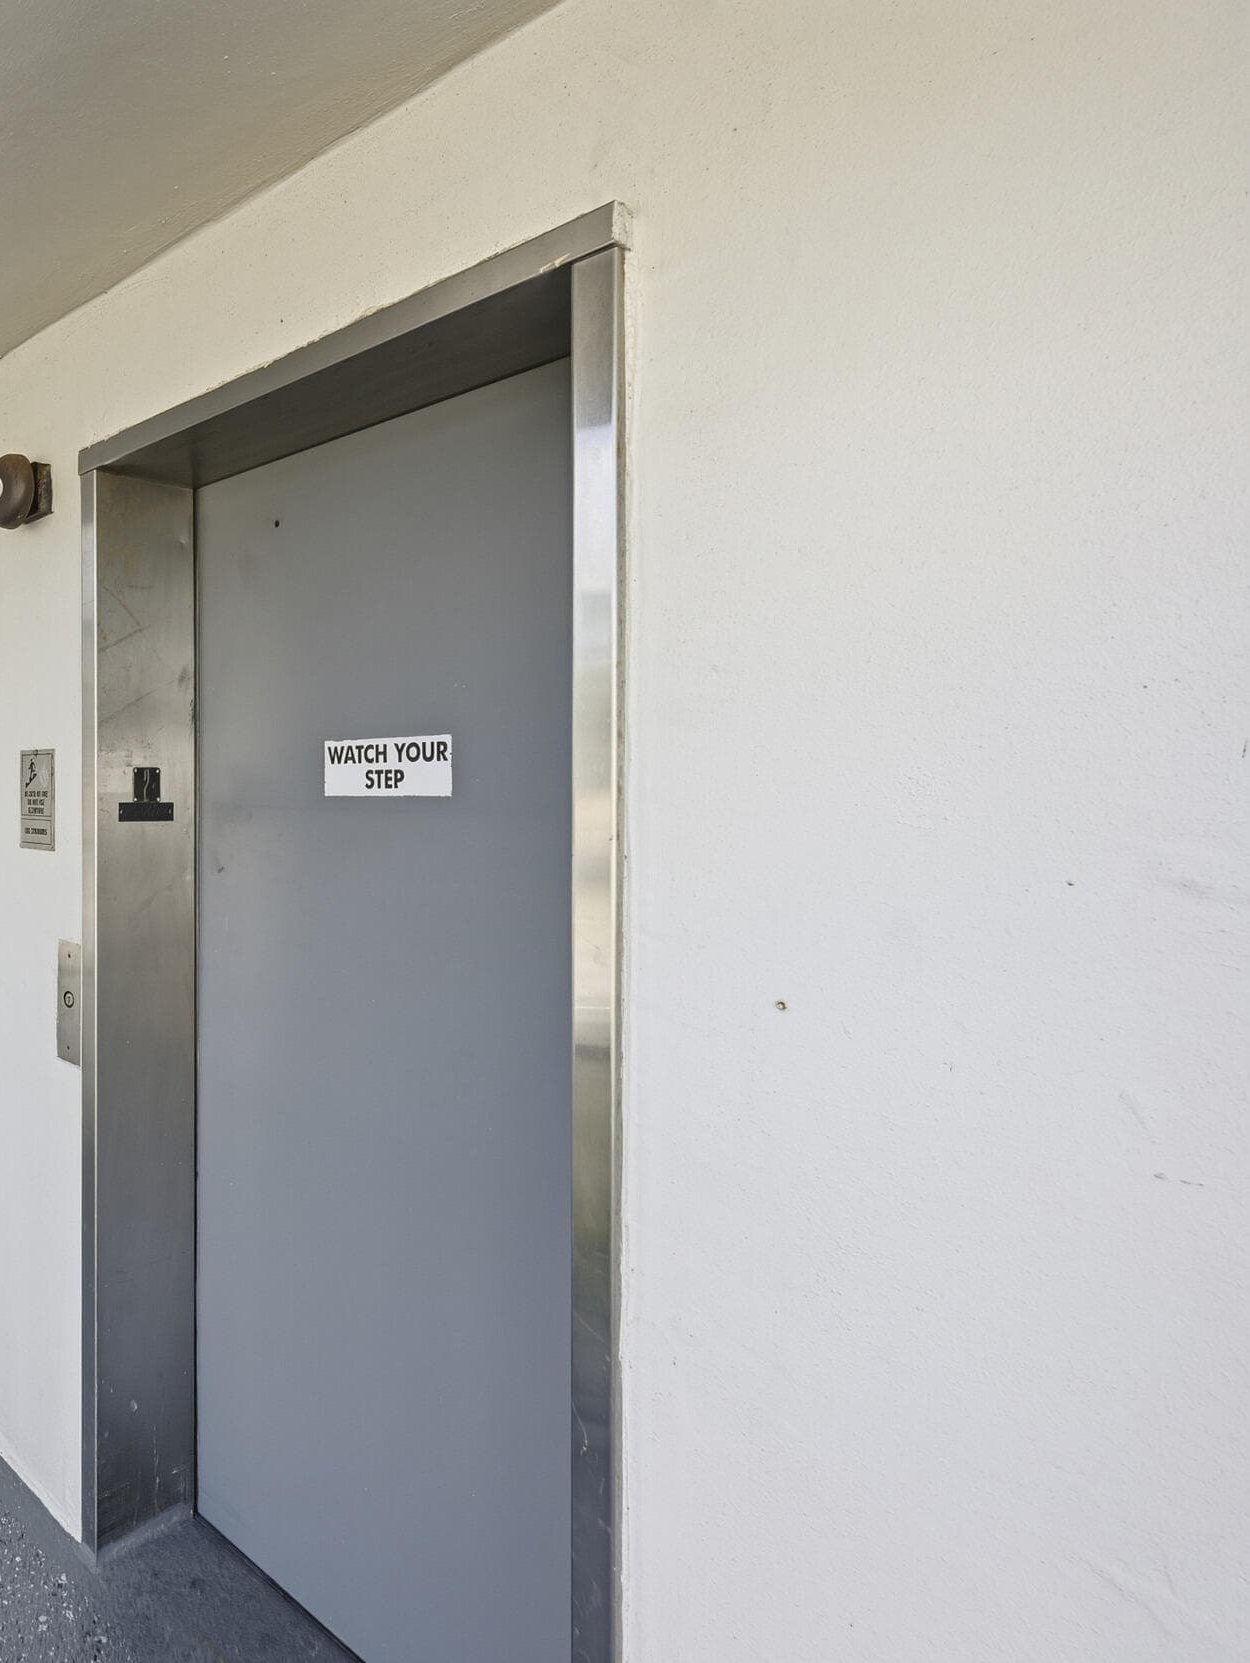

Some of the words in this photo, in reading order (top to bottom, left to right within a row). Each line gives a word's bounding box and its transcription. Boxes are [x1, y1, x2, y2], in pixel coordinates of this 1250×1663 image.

[328, 744, 387, 765] WATCH
[393, 741, 448, 763] YOUR
[365, 769, 404, 789] STEP
